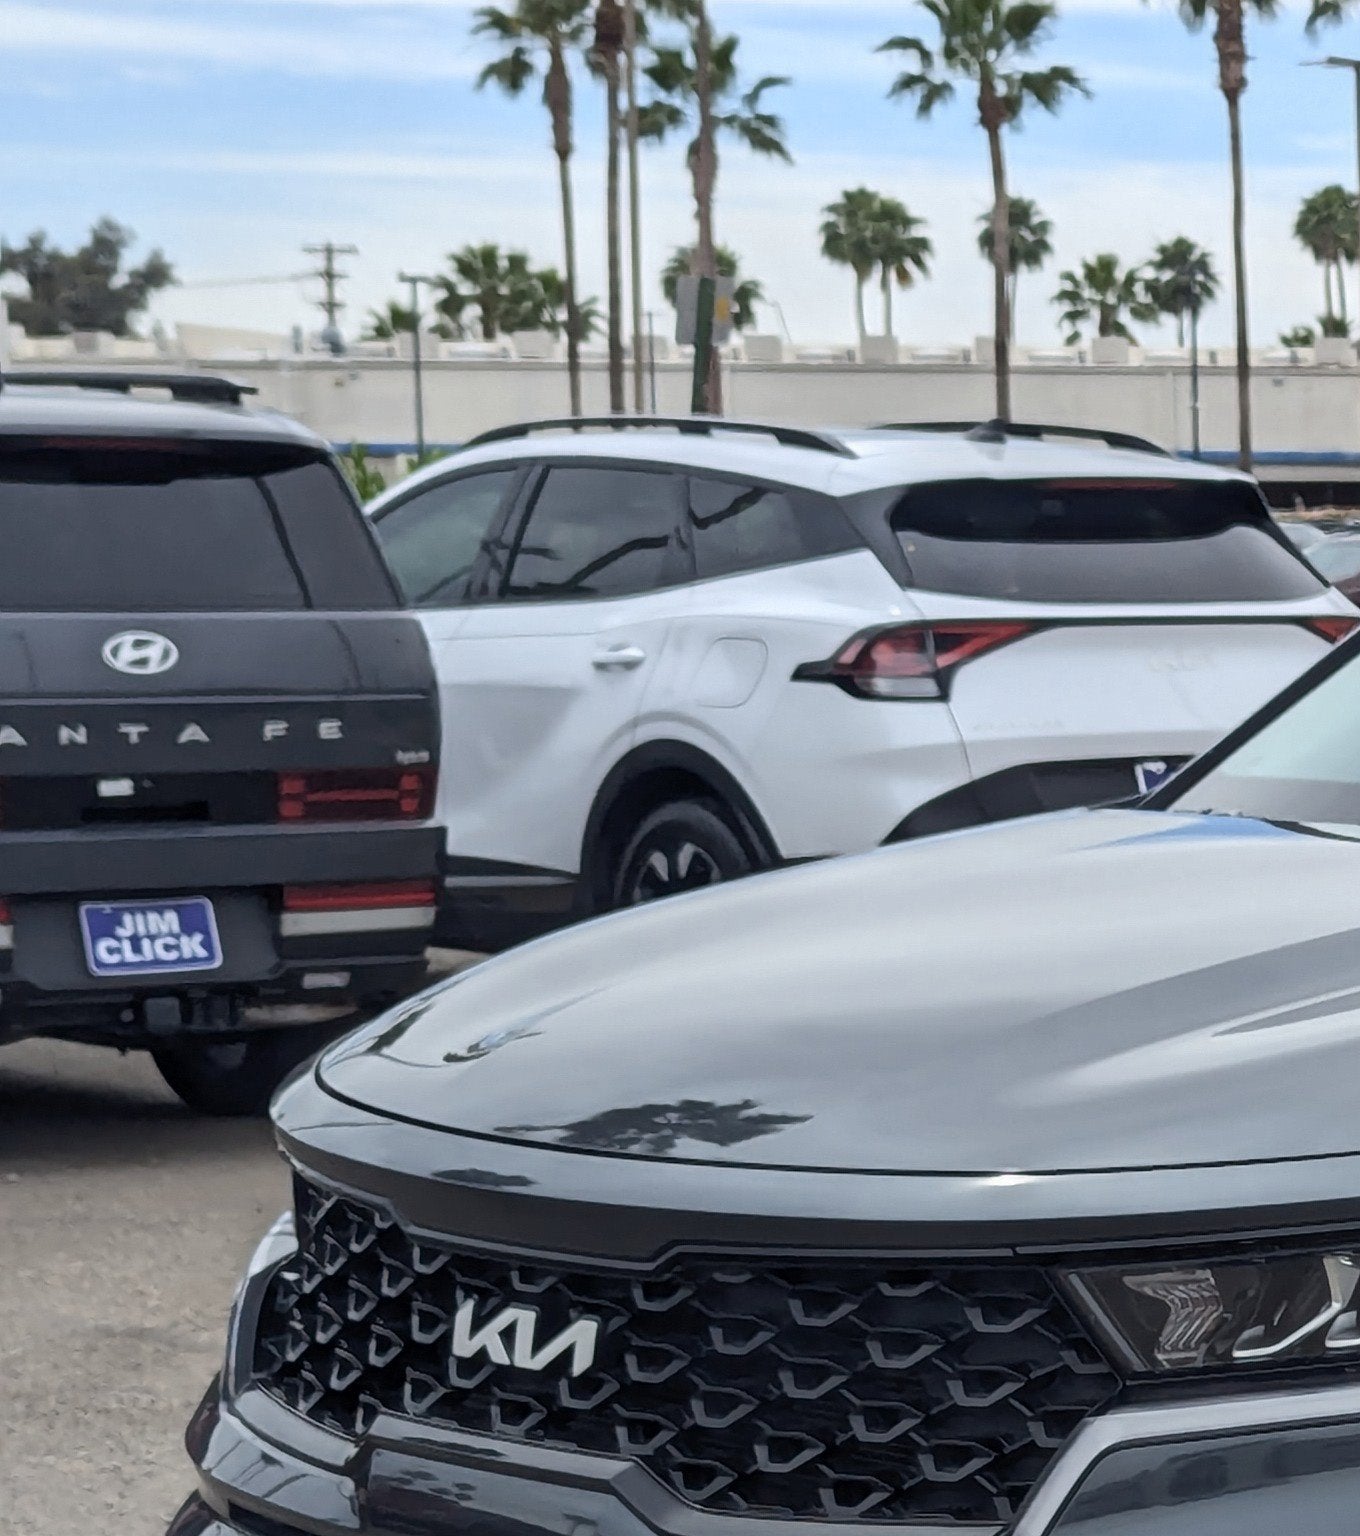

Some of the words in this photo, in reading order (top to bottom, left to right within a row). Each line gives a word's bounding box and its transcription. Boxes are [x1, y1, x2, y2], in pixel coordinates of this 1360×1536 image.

[262, 718, 344, 742] FE
[115, 908, 181, 938] JIM
[95, 931, 209, 965] CLICK
